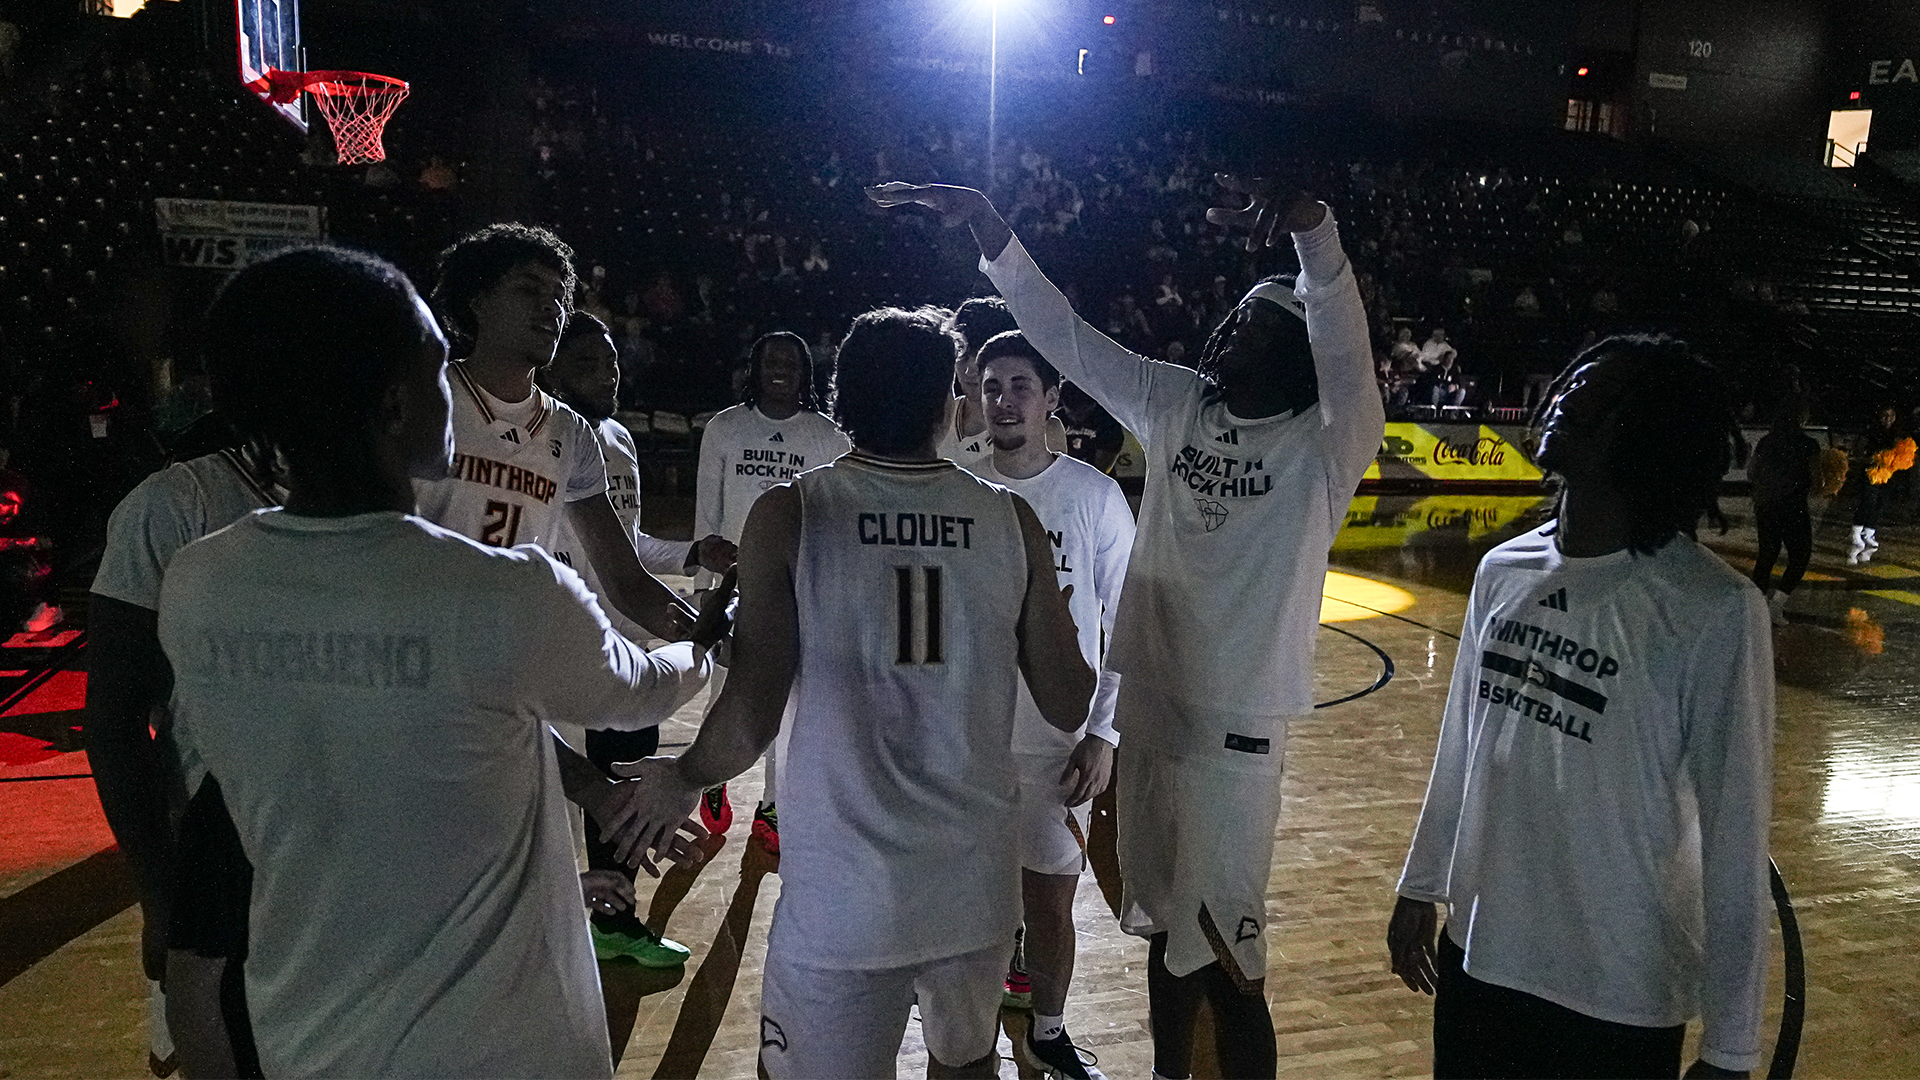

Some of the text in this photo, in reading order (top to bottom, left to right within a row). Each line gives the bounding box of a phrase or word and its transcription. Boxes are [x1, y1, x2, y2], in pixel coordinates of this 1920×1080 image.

[647, 32, 752, 54] WELCOME
[1688, 40, 1712, 58] 120
[1868, 59, 1919, 85] EA
[743, 449, 805, 467] BUILT IN
[1180, 444, 1238, 478] BUILT
[736, 464, 776, 478] ROCK
[1220, 475, 1273, 497] HILL
[482, 501, 523, 549] 21
[858, 513, 975, 549] CLOUET
[1048, 530, 1063, 547] N
[894, 566, 944, 665] 11
